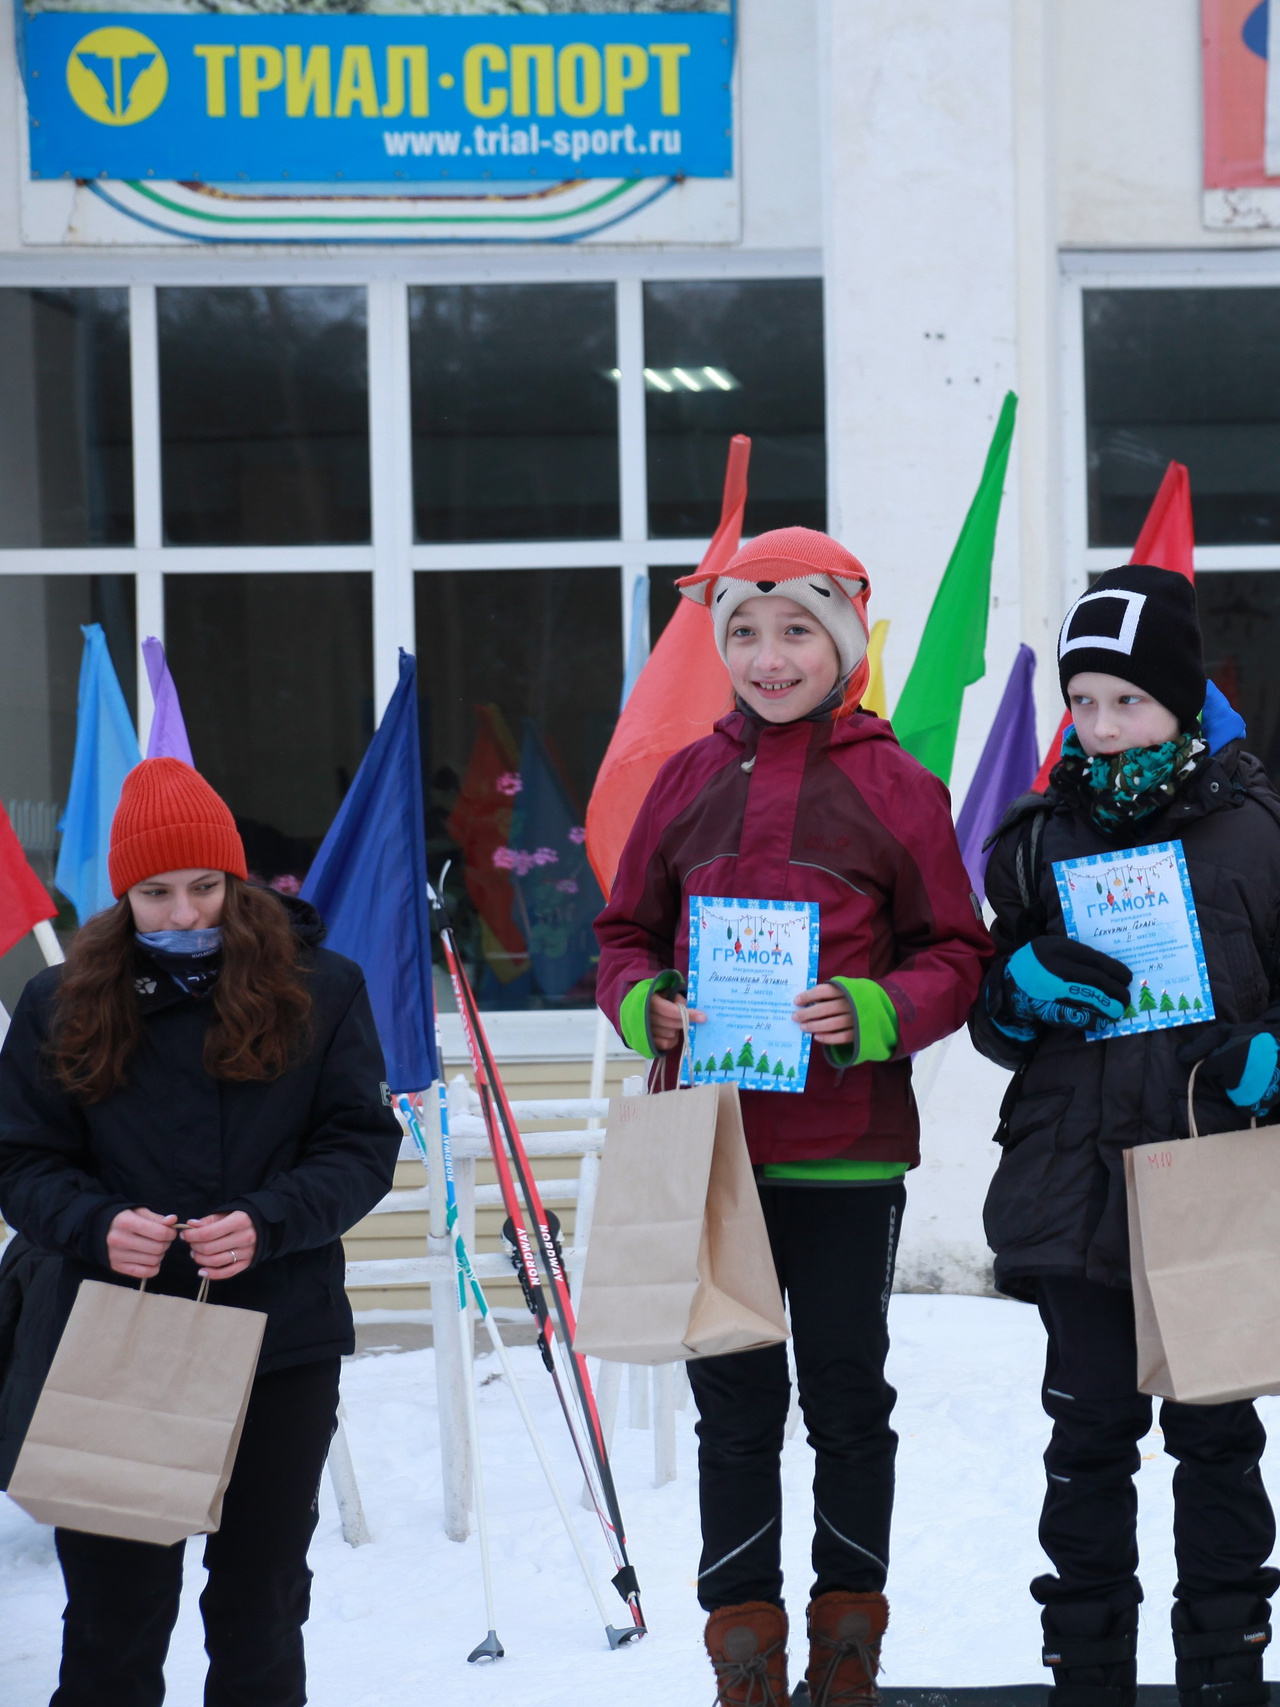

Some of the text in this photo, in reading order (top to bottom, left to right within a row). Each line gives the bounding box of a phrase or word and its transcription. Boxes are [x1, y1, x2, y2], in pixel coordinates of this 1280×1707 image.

[383, 123, 681, 160] www.trial-sport.ru
[1087, 892, 1169, 918] ГРАМОТА
[1137, 932, 1156, 940] МЕСТО
[713, 948, 793, 965] ГРАМОТА
[1069, 985, 1111, 1008] eska
[442, 1134, 455, 1182] NORDWAY
[516, 1227, 541, 1285] NORDWAY
[539, 1224, 564, 1282] NORDWAY
